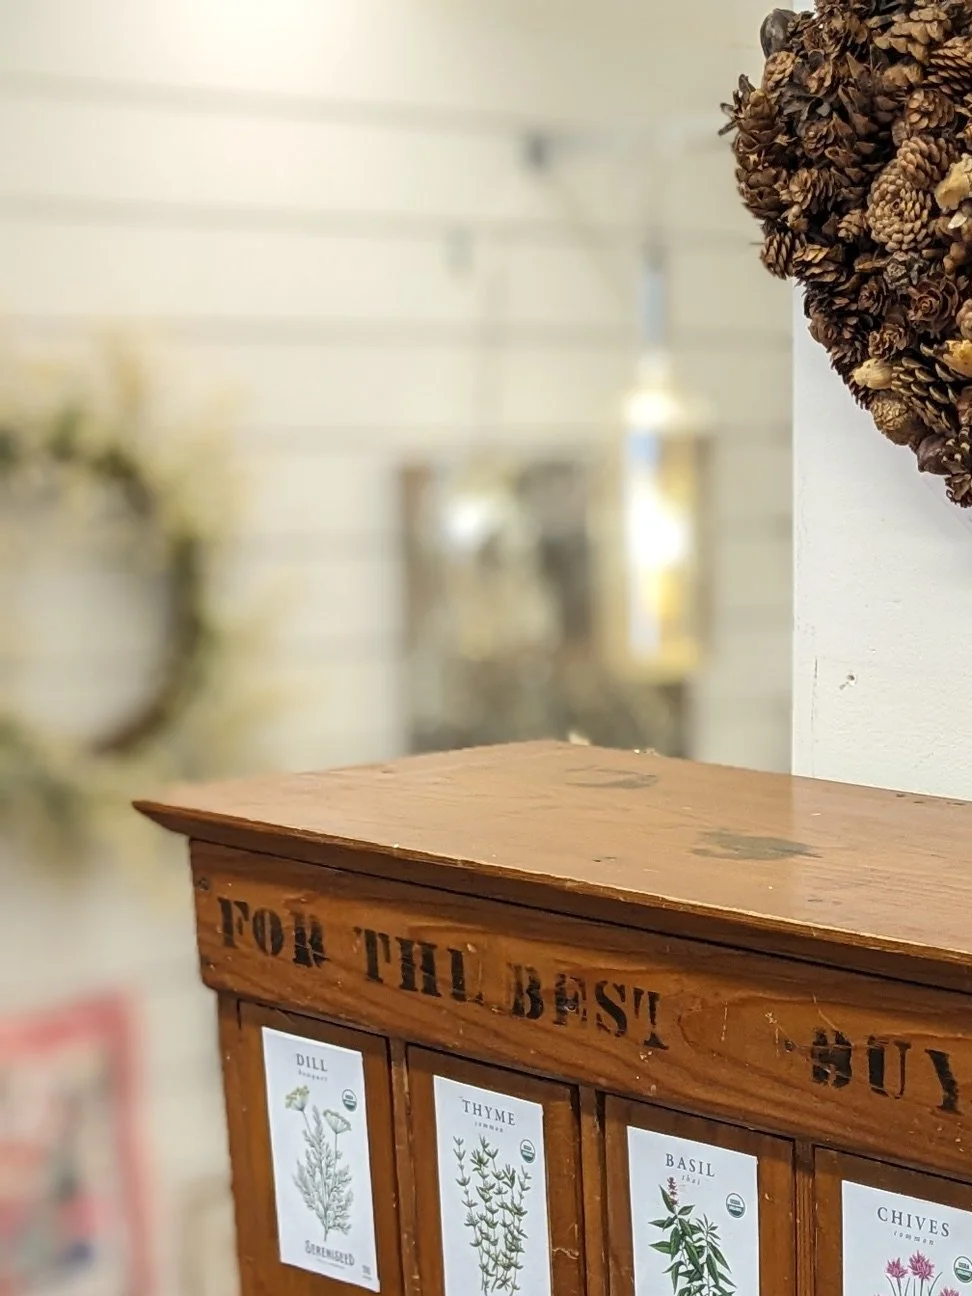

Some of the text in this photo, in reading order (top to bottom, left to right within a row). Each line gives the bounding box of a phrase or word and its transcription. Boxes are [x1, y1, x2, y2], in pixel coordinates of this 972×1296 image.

[218, 896, 330, 968] FOR
[506, 961, 669, 1050] BEST
[296, 1053, 328, 1072] DILL
[461, 1098, 516, 1126] THYME
[665, 1152, 716, 1178] BASIL
[877, 1206, 950, 1237] CHIVES
